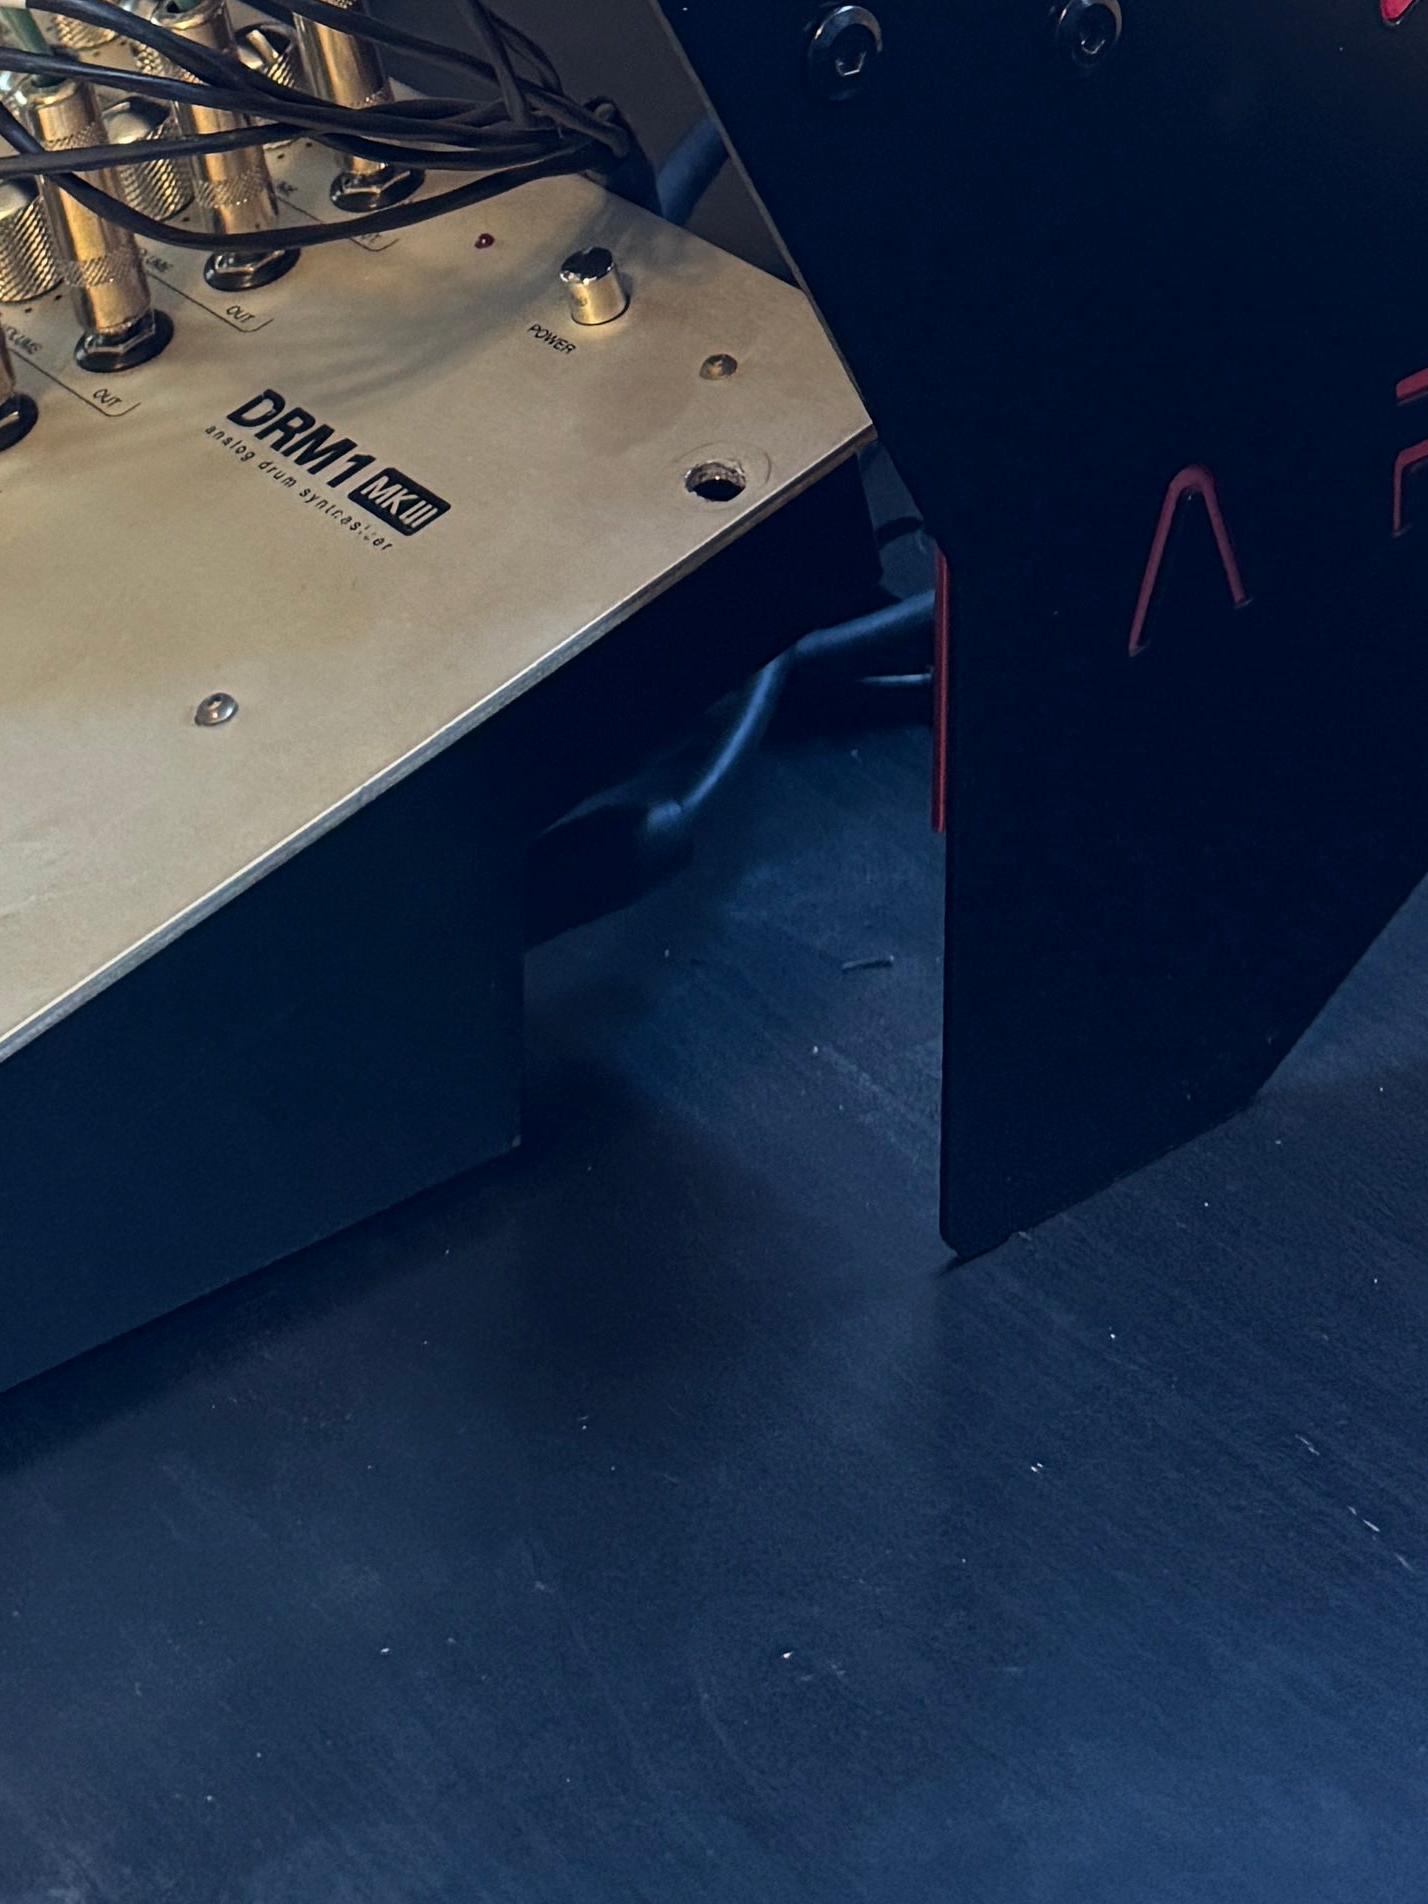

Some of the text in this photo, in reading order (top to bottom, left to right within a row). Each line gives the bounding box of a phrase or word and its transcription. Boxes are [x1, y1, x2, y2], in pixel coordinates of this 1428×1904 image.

[226, 303, 255, 324] OUT
[527, 322, 577, 355] POWER
[92, 388, 122, 408] OUT
[226, 387, 377, 489] DRM1
[204, 423, 257, 464] analog
[258, 458, 298, 489] drum
